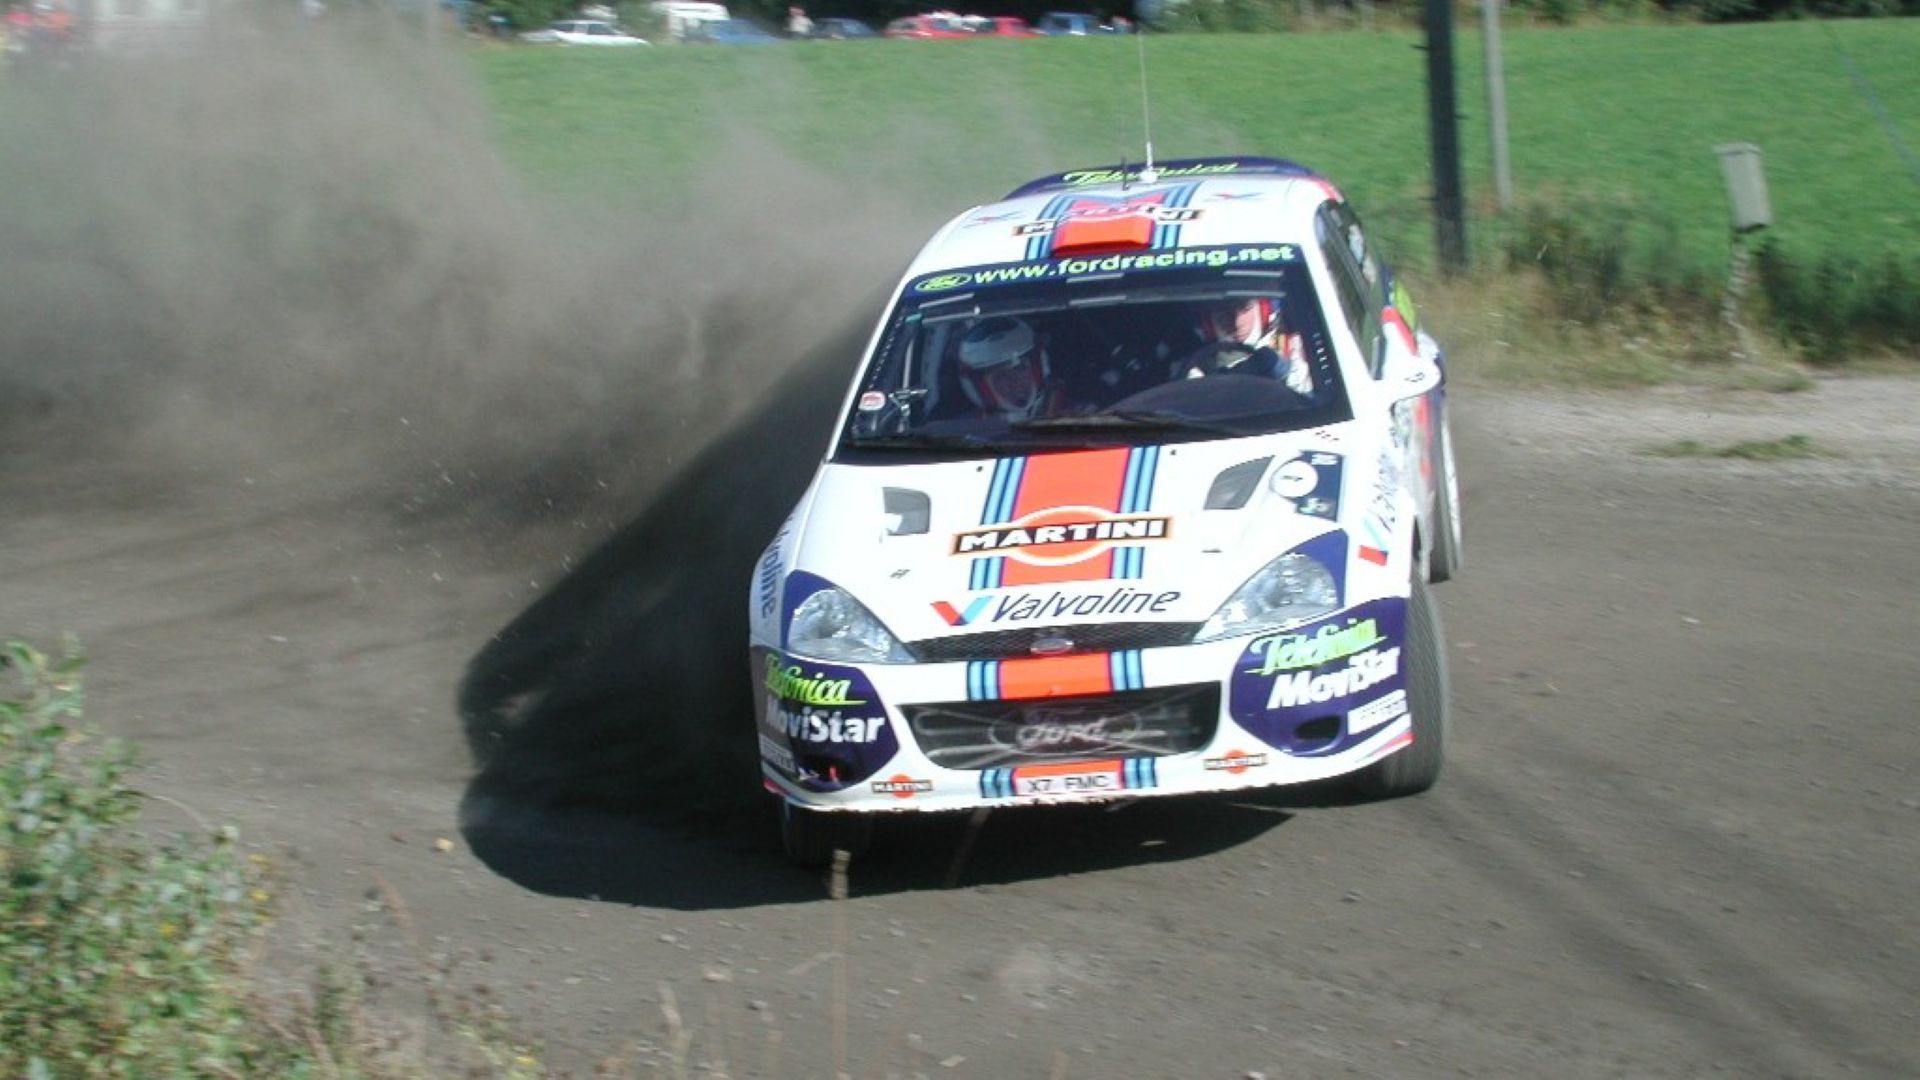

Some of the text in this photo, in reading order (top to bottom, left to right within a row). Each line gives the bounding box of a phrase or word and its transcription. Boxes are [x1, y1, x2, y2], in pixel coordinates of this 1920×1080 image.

[974, 245, 1295, 284] www.fordracing.net
[958, 518, 1165, 553] MARTINI
[990, 588, 1181, 623] Valvoline
[1064, 774, 1110, 791] FMC
